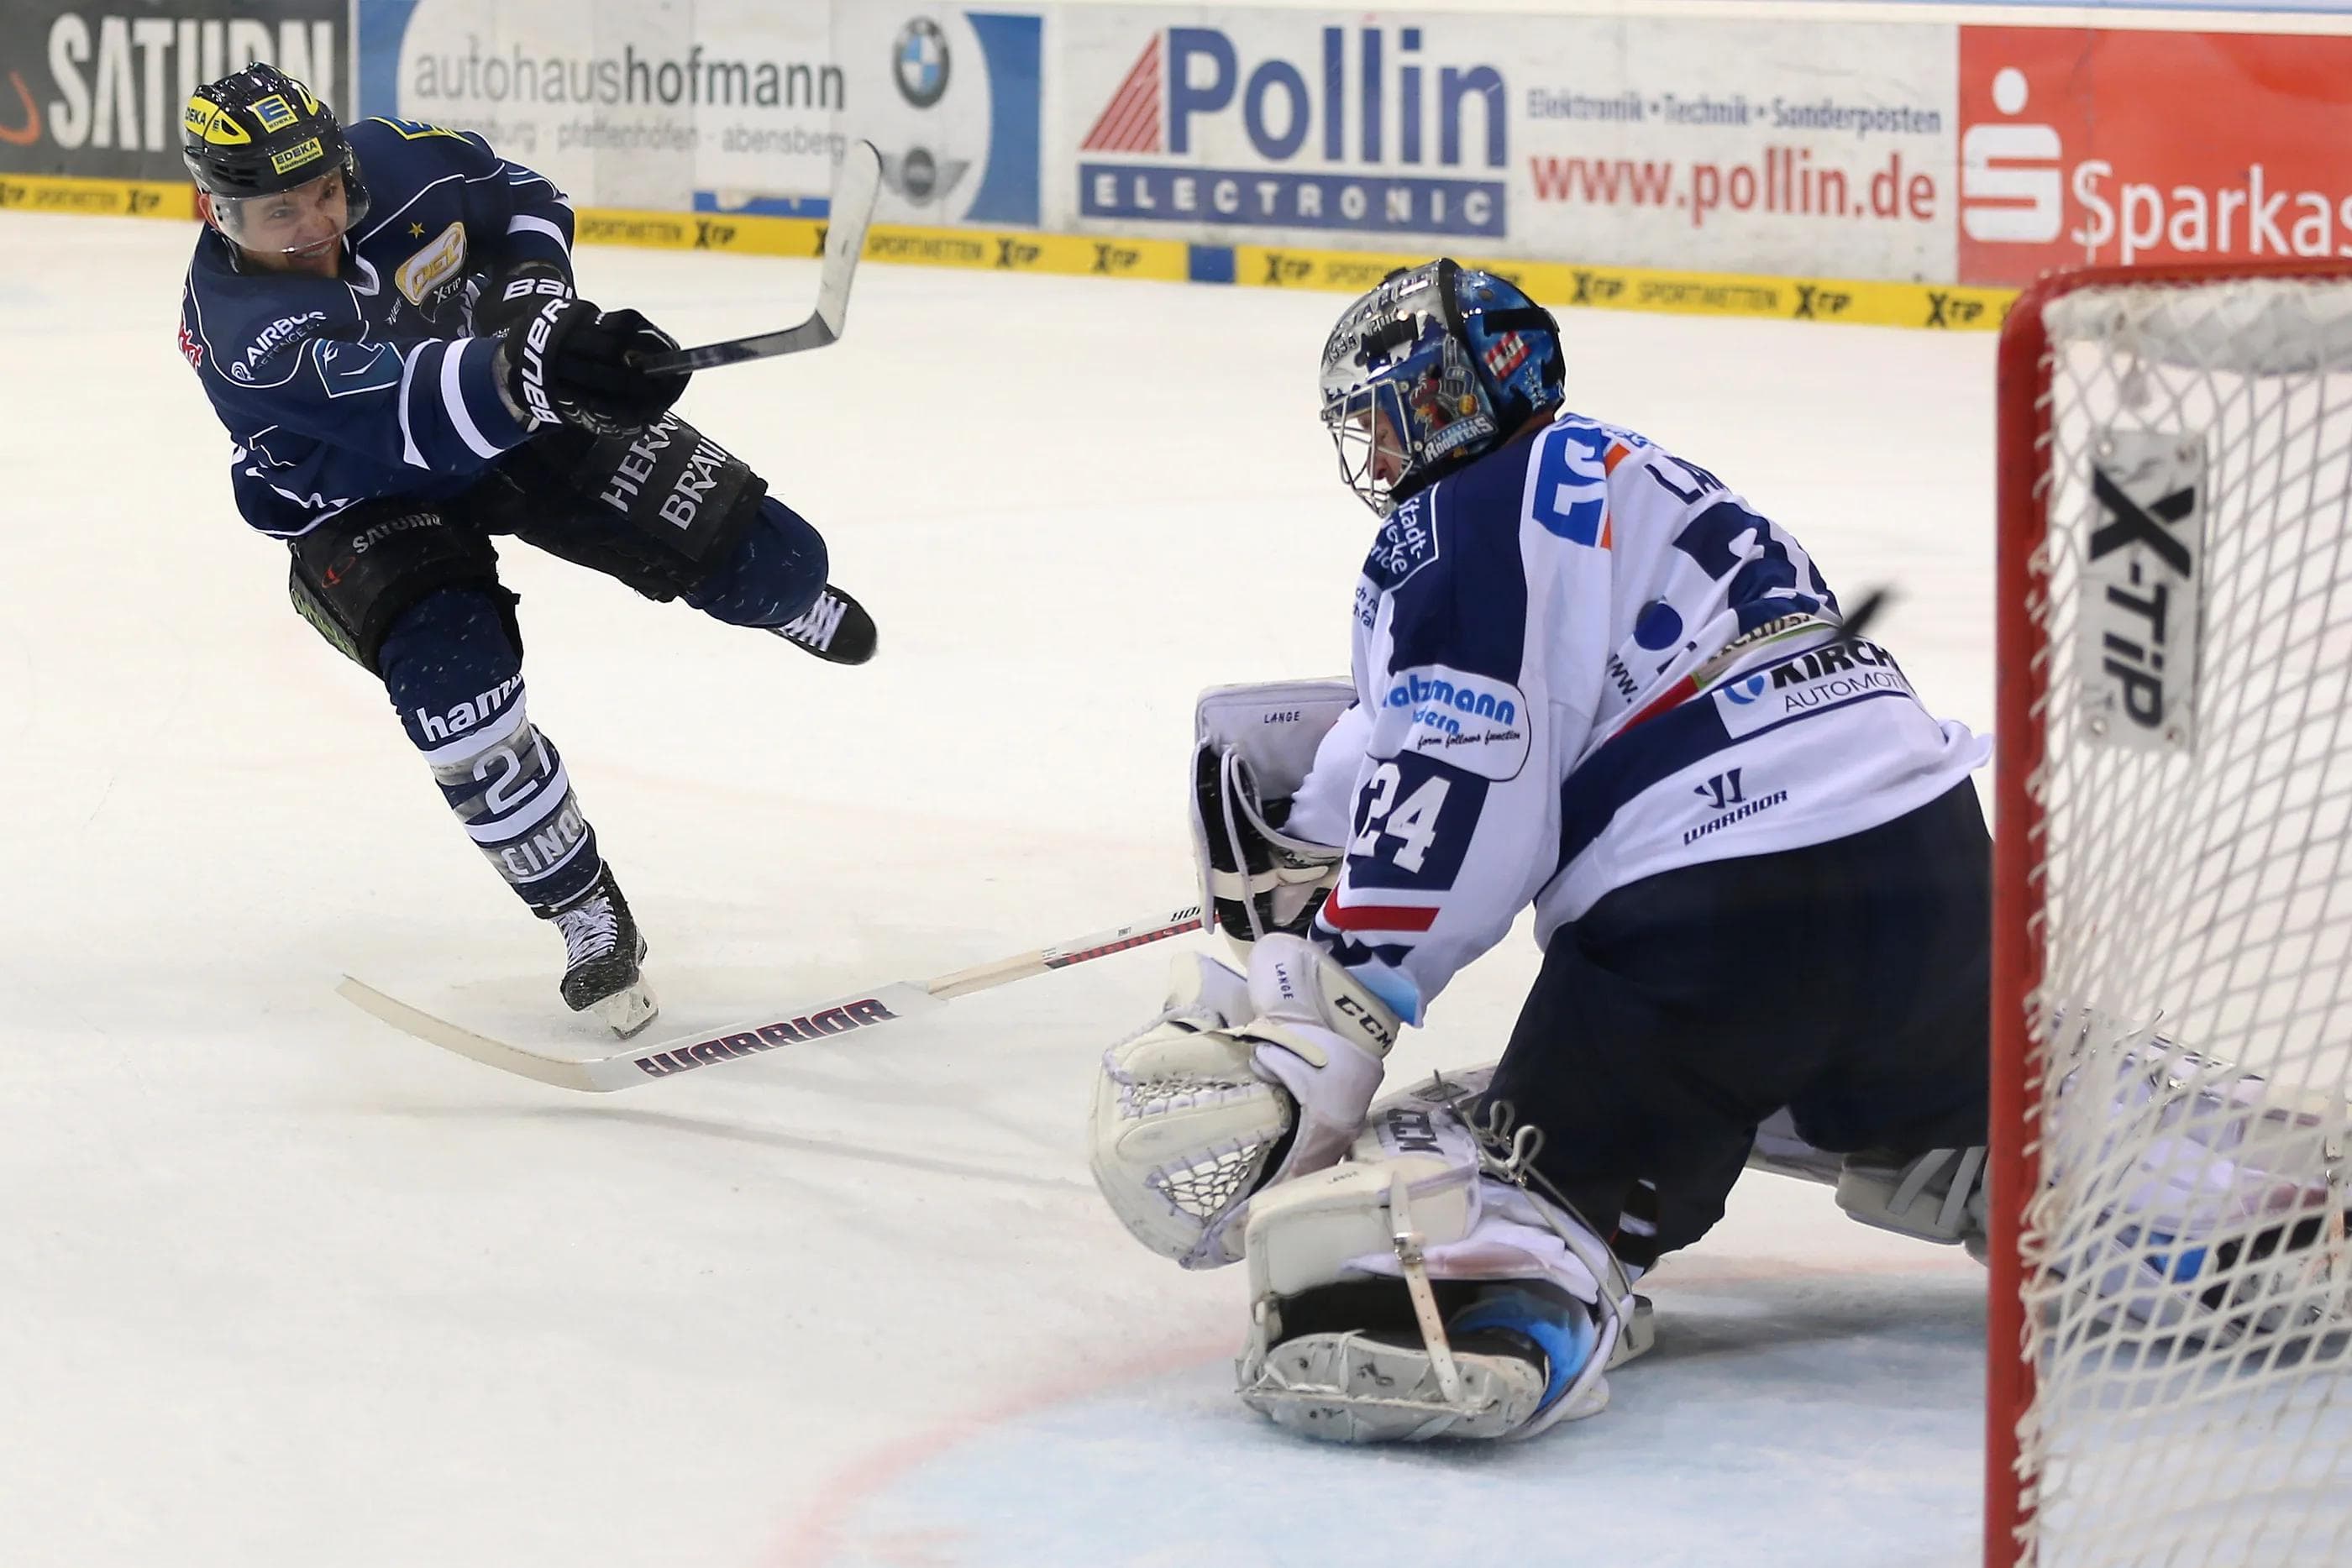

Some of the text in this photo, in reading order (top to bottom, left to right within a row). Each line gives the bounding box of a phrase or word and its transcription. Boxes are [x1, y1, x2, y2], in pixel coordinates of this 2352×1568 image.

[414, 45, 846, 111] autohaushofmann
[1167, 27, 1506, 165] Pollin
[186, 106, 207, 126] DEKA
[1526, 89, 1942, 139] Elektronik Technik Sonderposten
[276, 140, 318, 164] EDEKA
[1095, 177, 1494, 226] ELECTRONIC
[1529, 145, 1937, 227] www.pollin.de
[246, 311, 327, 367] AIRBUS
[352, 512, 444, 554] SATURN
[1263, 711, 1301, 725] LANGE
[1383, 674, 1515, 726] atzmann
[1417, 734, 1443, 751] form
[1350, 761, 1453, 874] 24
[1683, 788, 1788, 847] WARRIOR
[1275, 962, 1294, 1001] LANGE
[633, 999, 903, 1078] WARRIOR
[1334, 994, 1393, 1050] CCM
